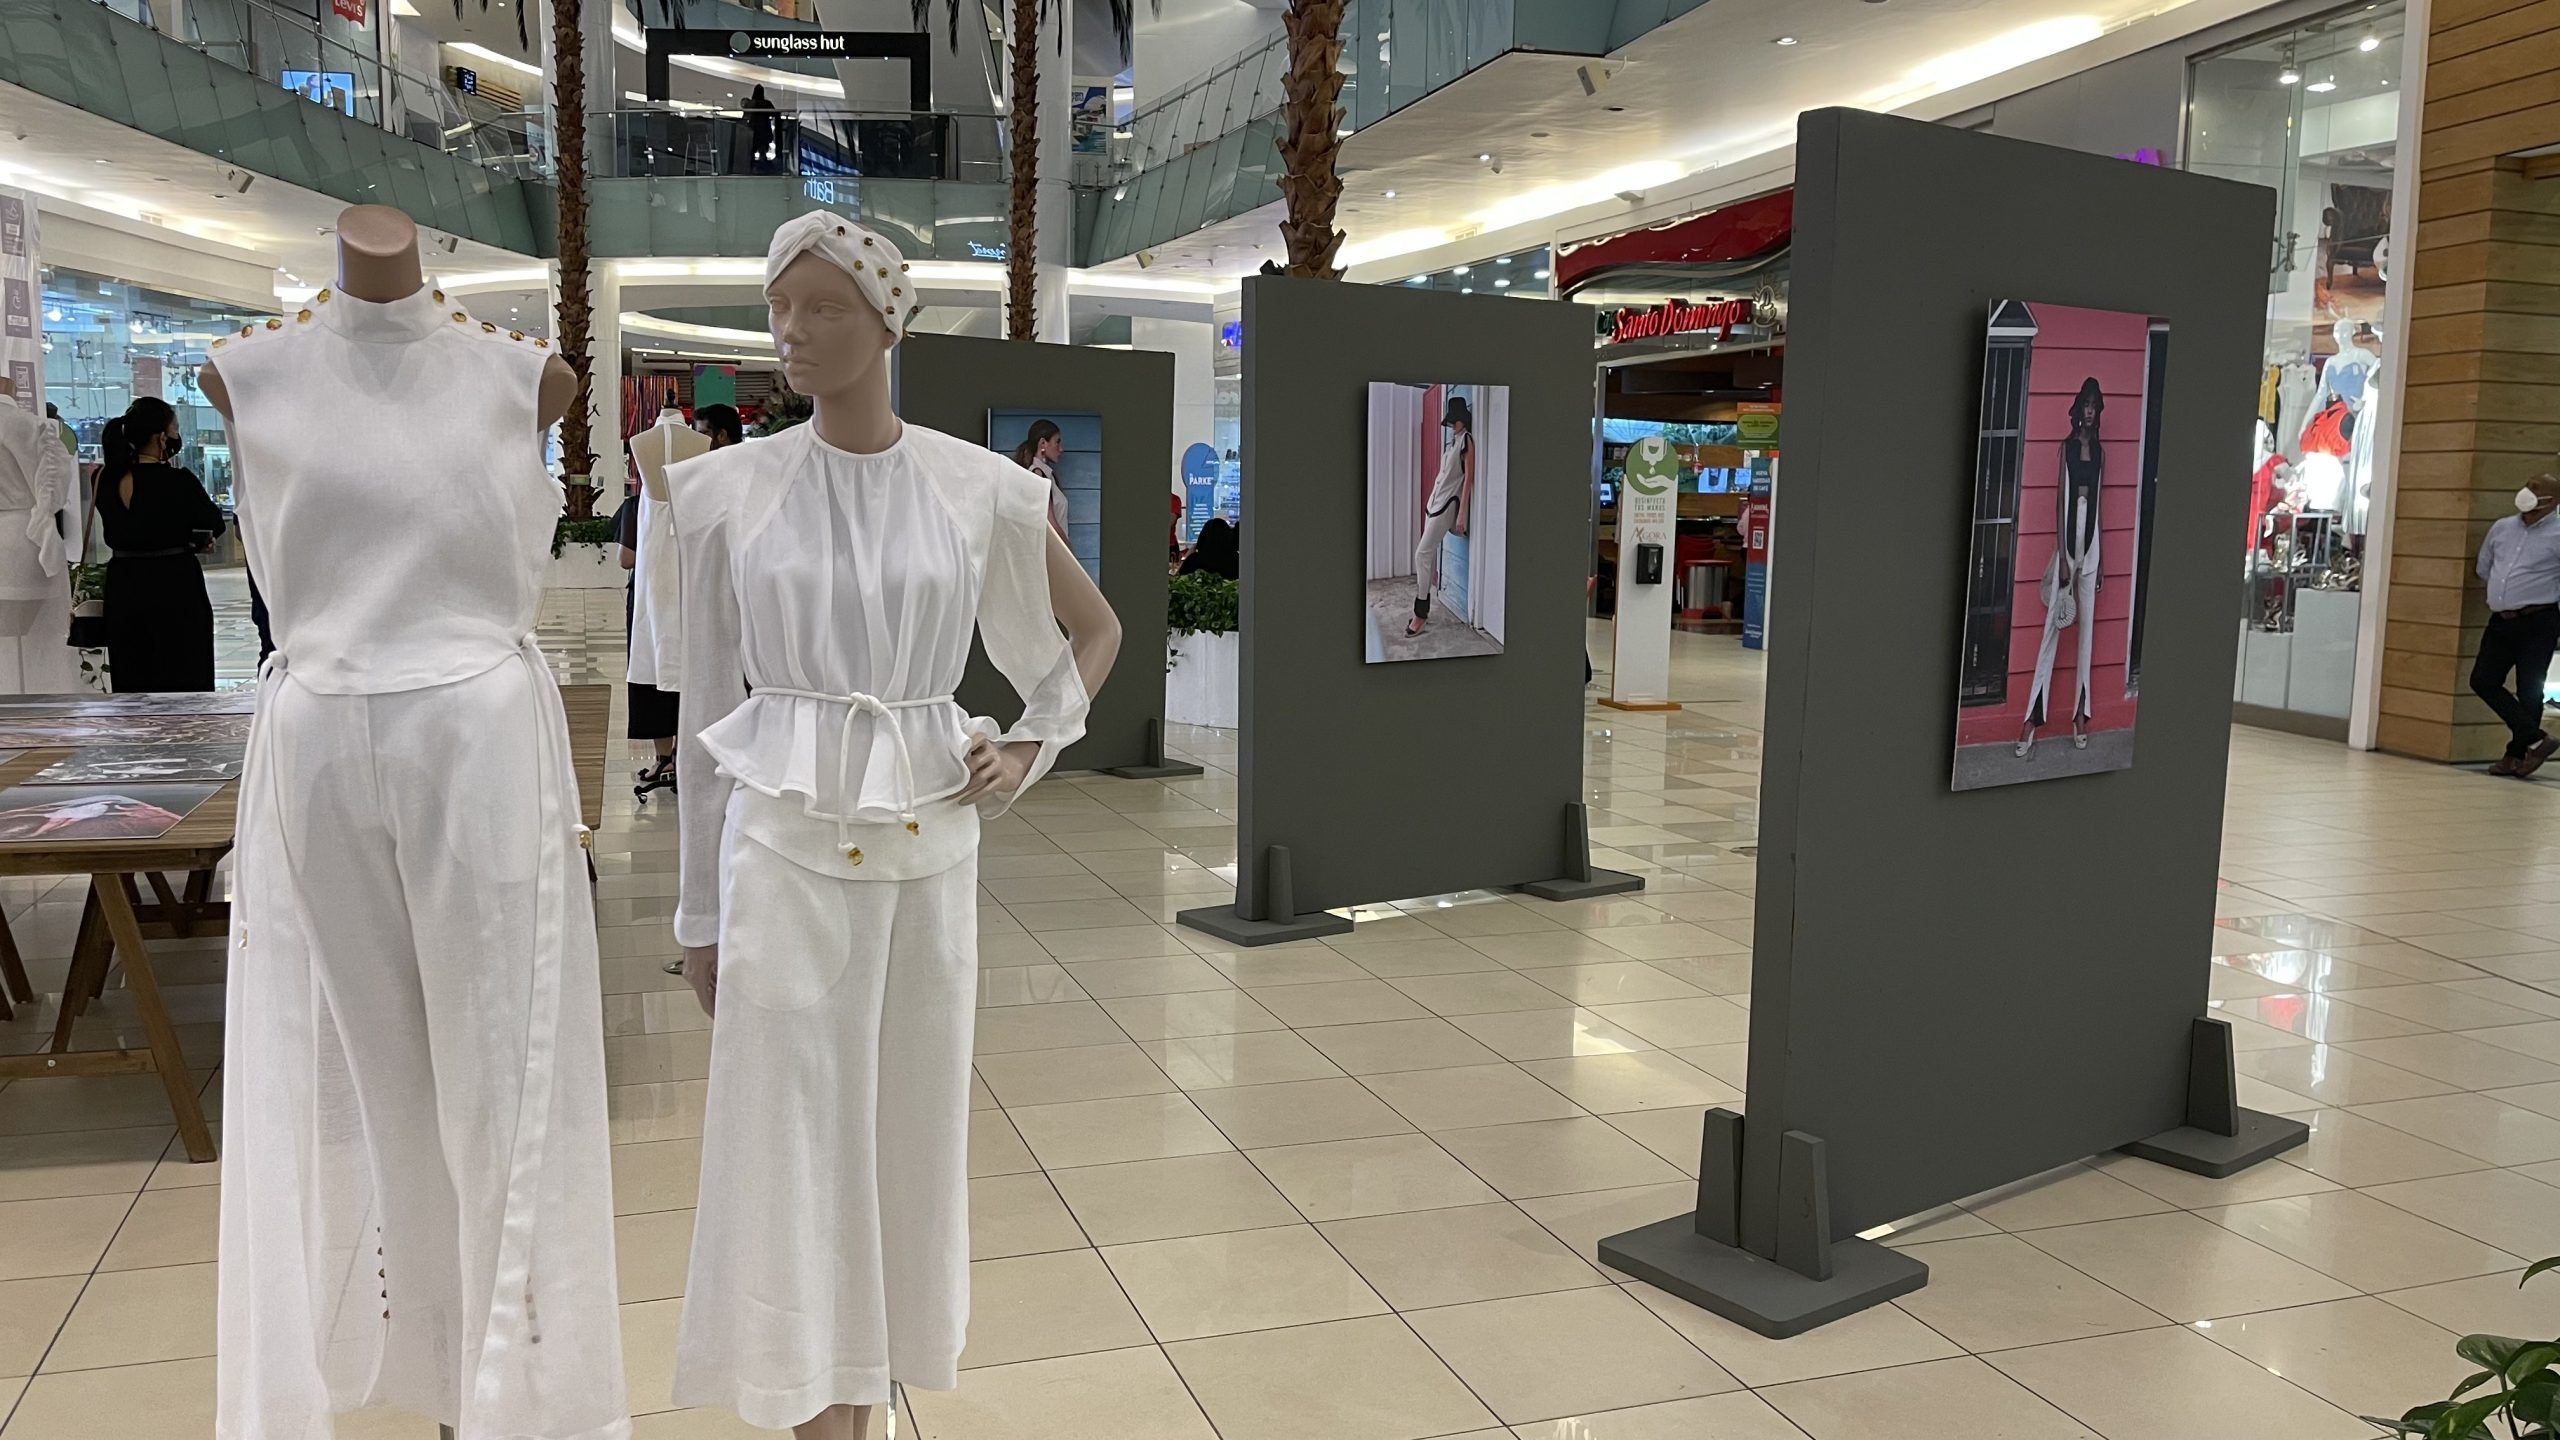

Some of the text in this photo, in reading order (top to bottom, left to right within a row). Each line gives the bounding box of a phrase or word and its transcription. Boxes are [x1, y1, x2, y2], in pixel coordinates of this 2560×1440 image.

[753, 33, 845, 54] sunglass hut
[1611, 303, 1660, 344] Santo
[1659, 297, 1742, 342] Domingo
